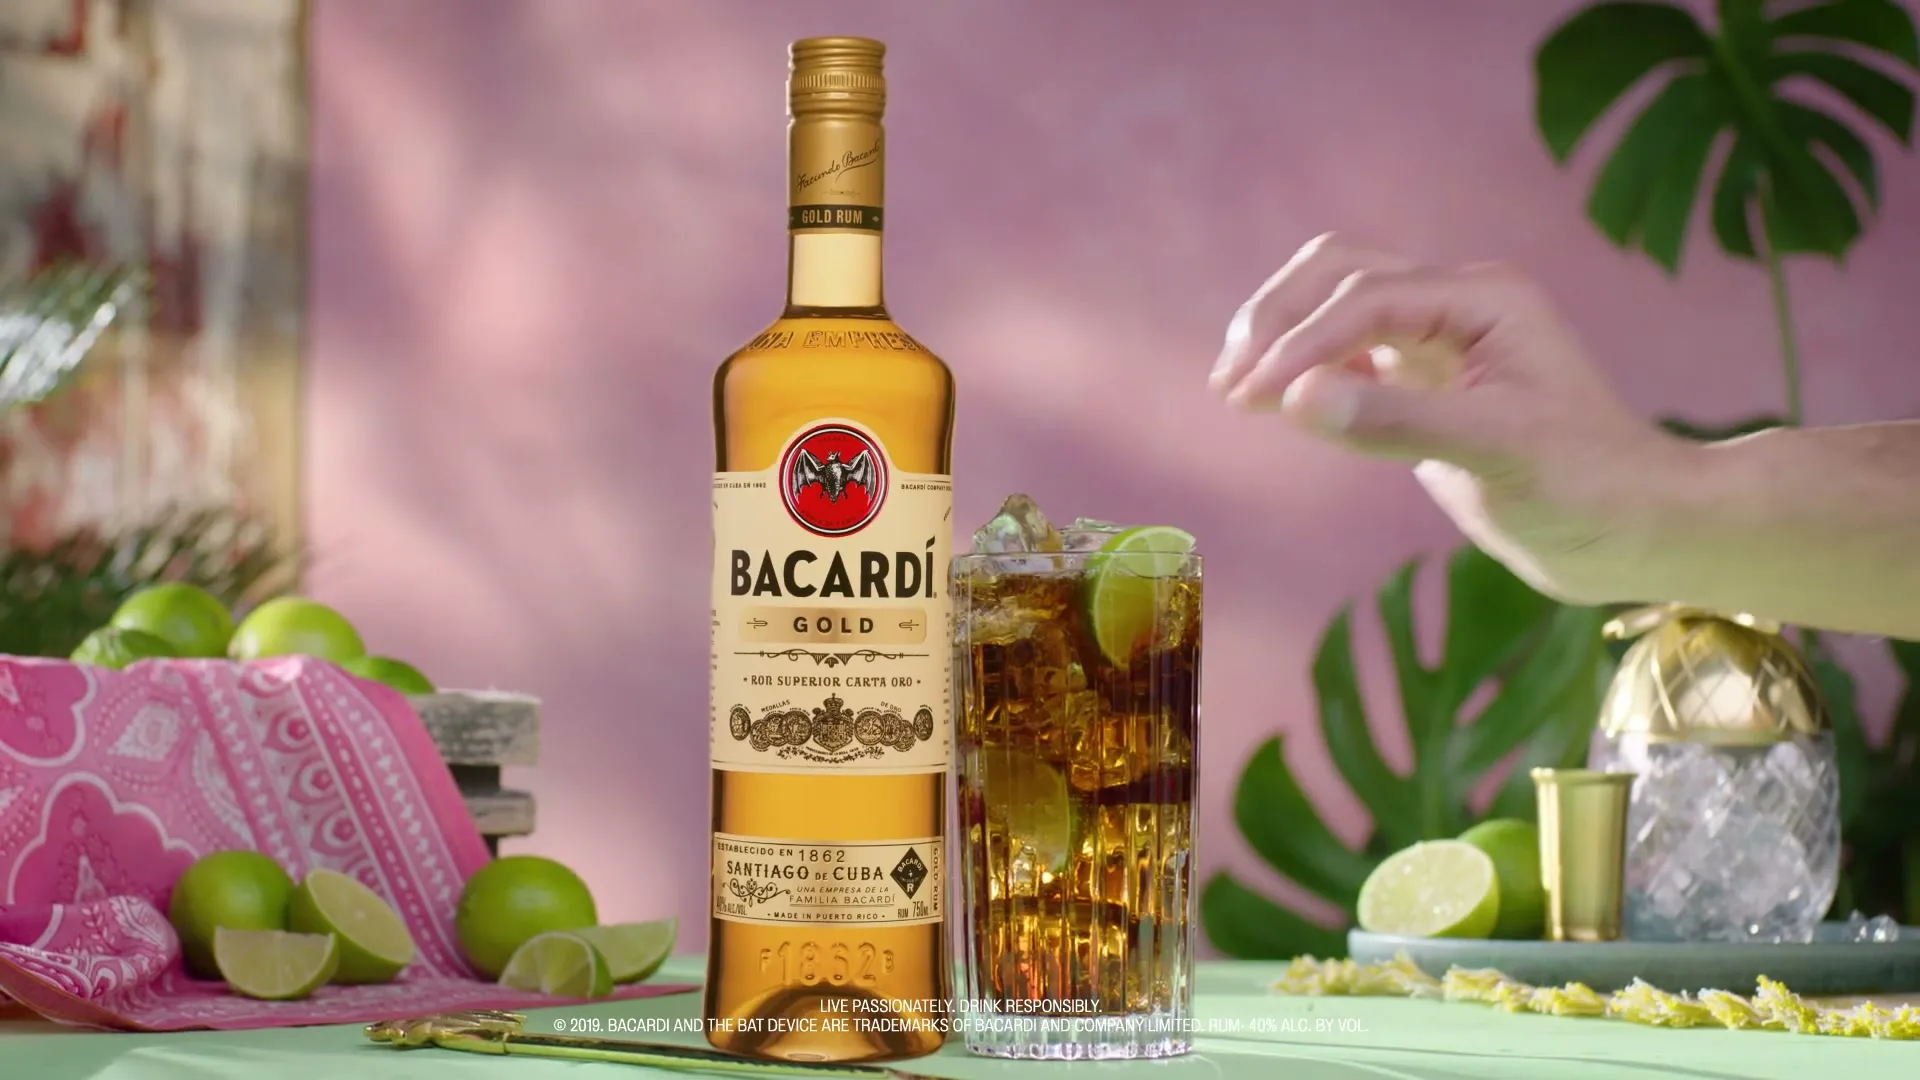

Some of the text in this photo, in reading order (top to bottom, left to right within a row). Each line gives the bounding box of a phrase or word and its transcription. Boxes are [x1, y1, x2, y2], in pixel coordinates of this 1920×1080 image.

[802, 209, 863, 225] GOLD RUM
[731, 535, 936, 599] BACARDÍ
[793, 617, 875, 634] GOLD
[777, 675, 841, 688] SUPERIOR
[846, 676, 887, 688] CARTA
[891, 676, 913, 688] ORO
[761, 699, 791, 713] MEDALLAS
[717, 842, 845, 862] ESTABLECIDO EN 1862
[727, 860, 883, 881] SANTIAGO DE CUBA
[819, 886, 861, 894] EMPRESA
[865, 886, 877, 894] DE
[907, 883, 914, 892] R
[789, 894, 838, 904] FAMILIA
